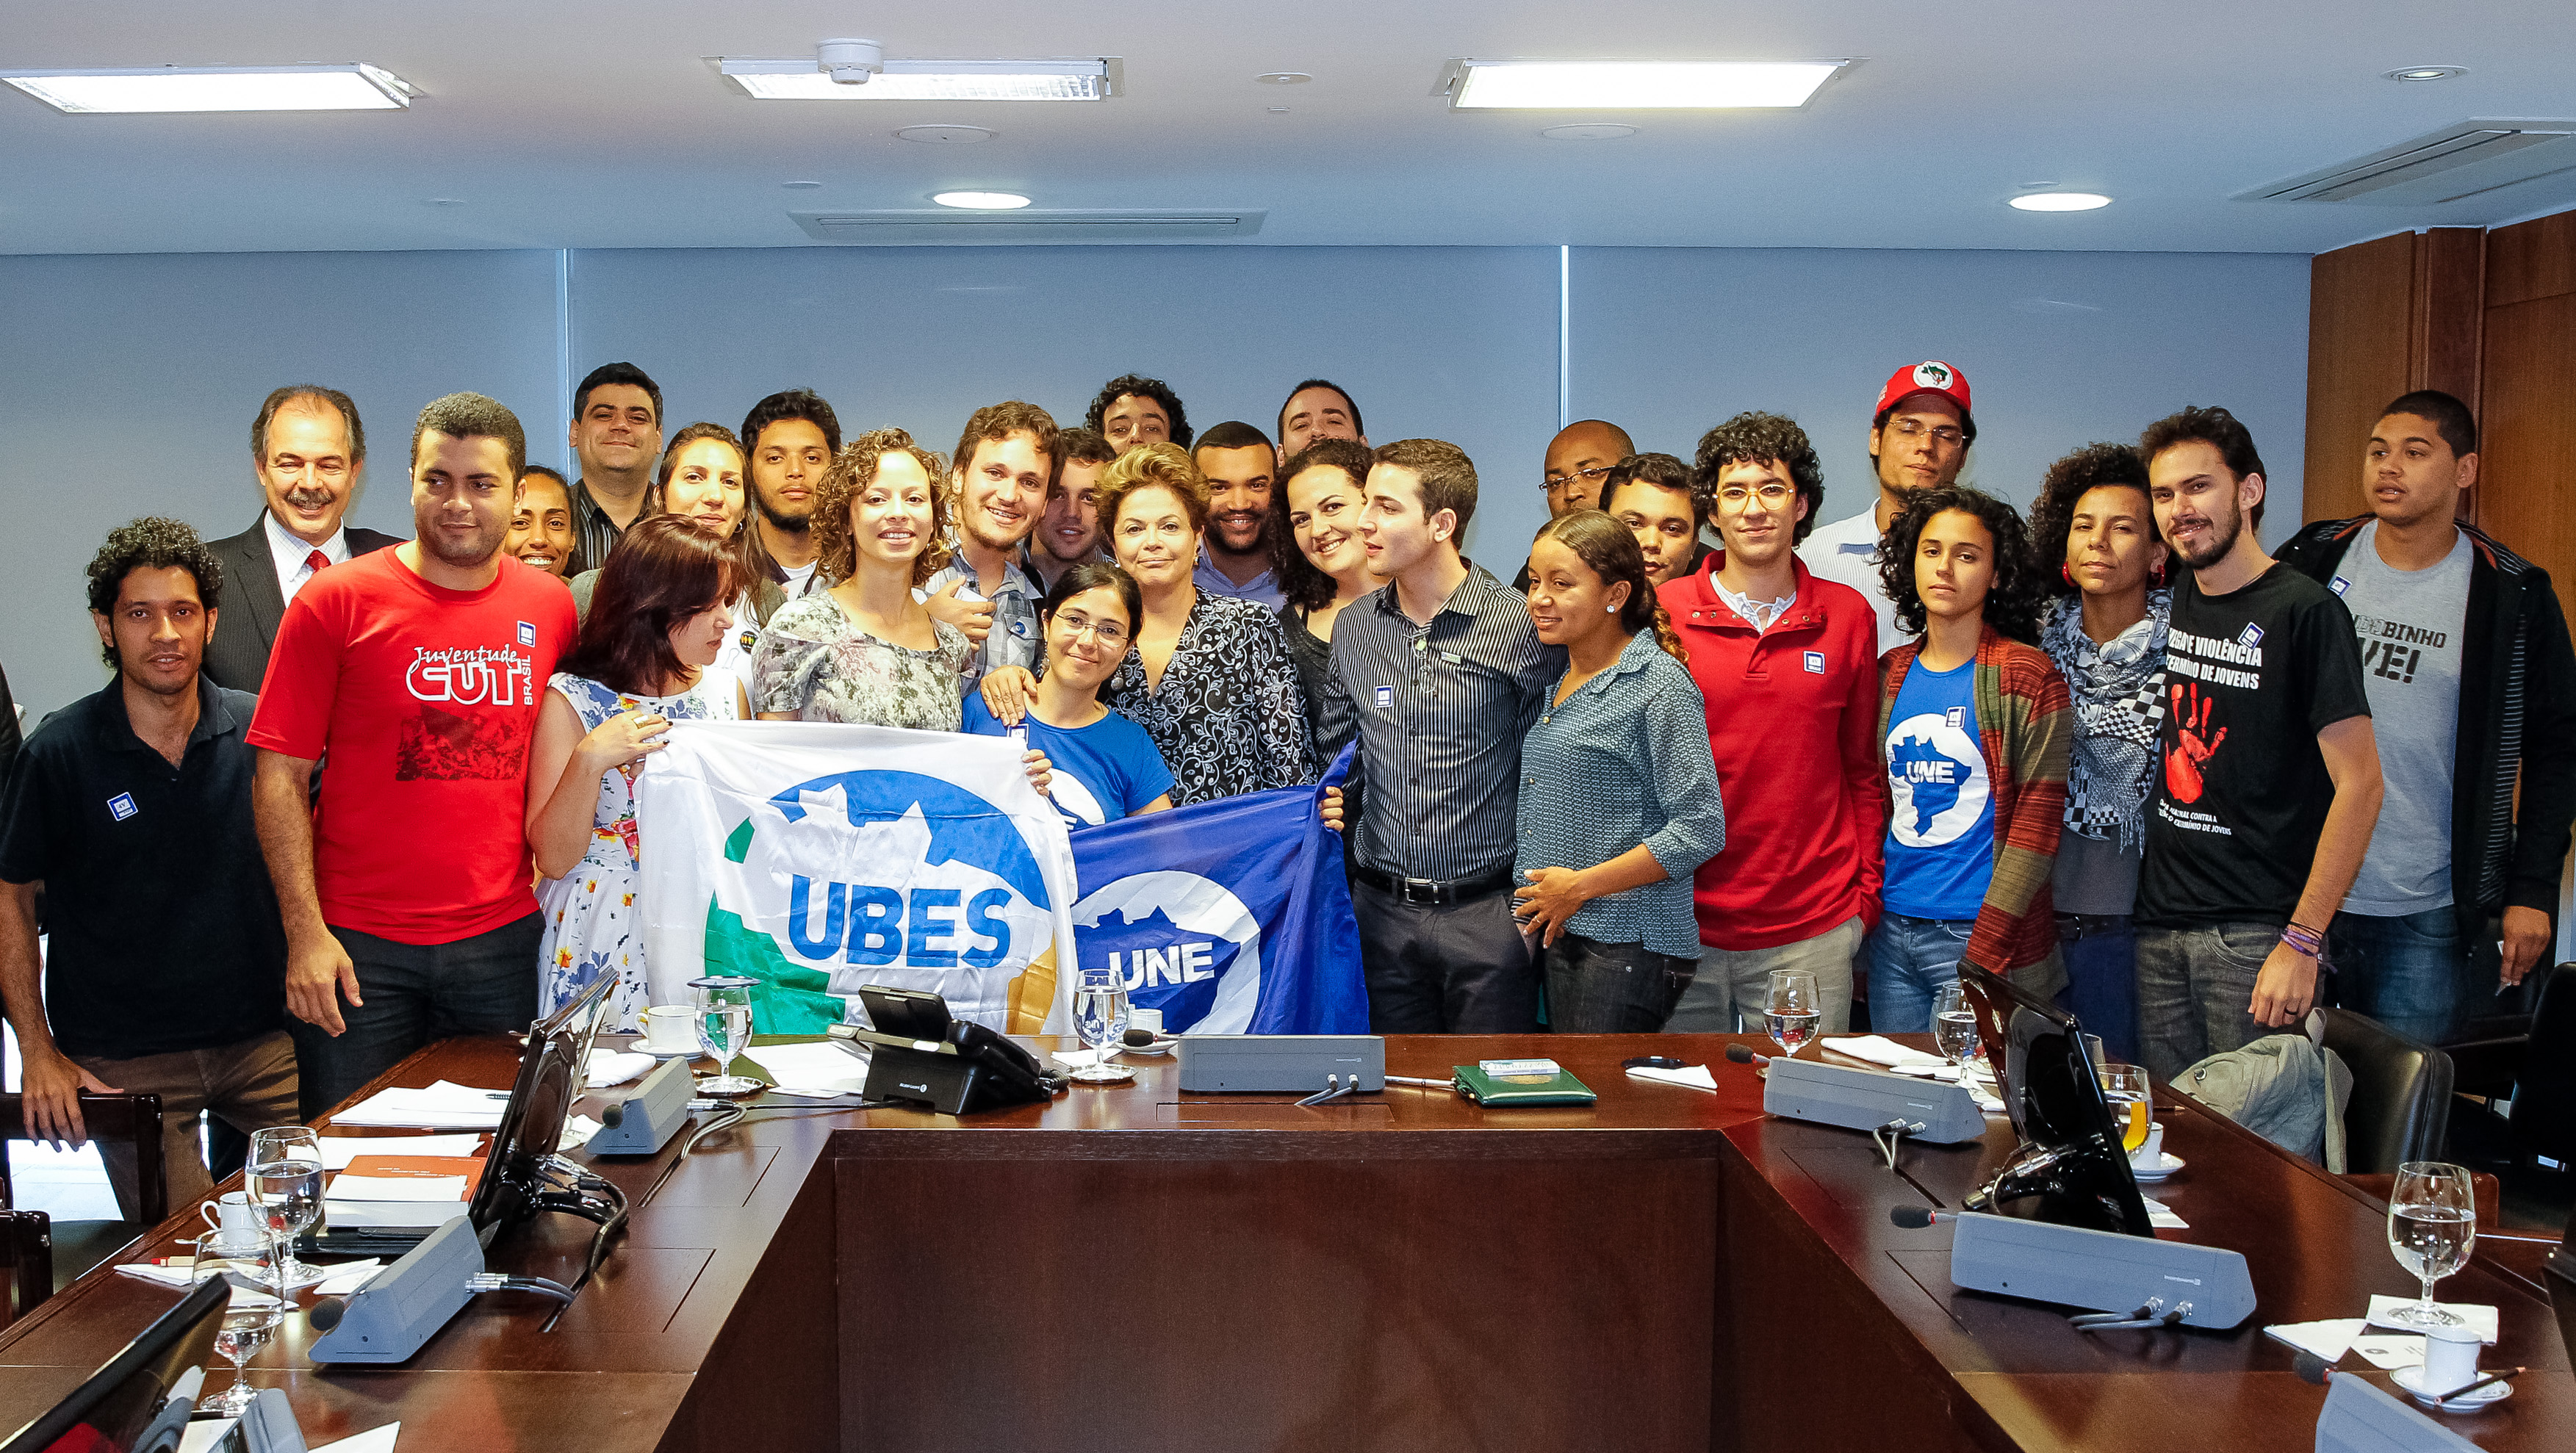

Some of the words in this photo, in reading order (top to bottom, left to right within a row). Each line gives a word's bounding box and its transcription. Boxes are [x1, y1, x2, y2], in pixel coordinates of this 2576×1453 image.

[409, 643, 518, 674] Juventude
[2195, 636, 2262, 667] VIOLÊNCIA
[521, 655, 533, 706] BRASIL
[2200, 663, 2215, 682] DE
[2213, 666, 2260, 690] JOVENS
[1906, 760, 1956, 784] UNE
[2190, 812, 2213, 823] CONTRA
[2213, 815, 2218, 823] A
[2201, 823, 2212, 832] DE
[2211, 824, 2232, 836] JOVENS
[788, 873, 1013, 968] UBES
[1108, 940, 1215, 992] UNE
